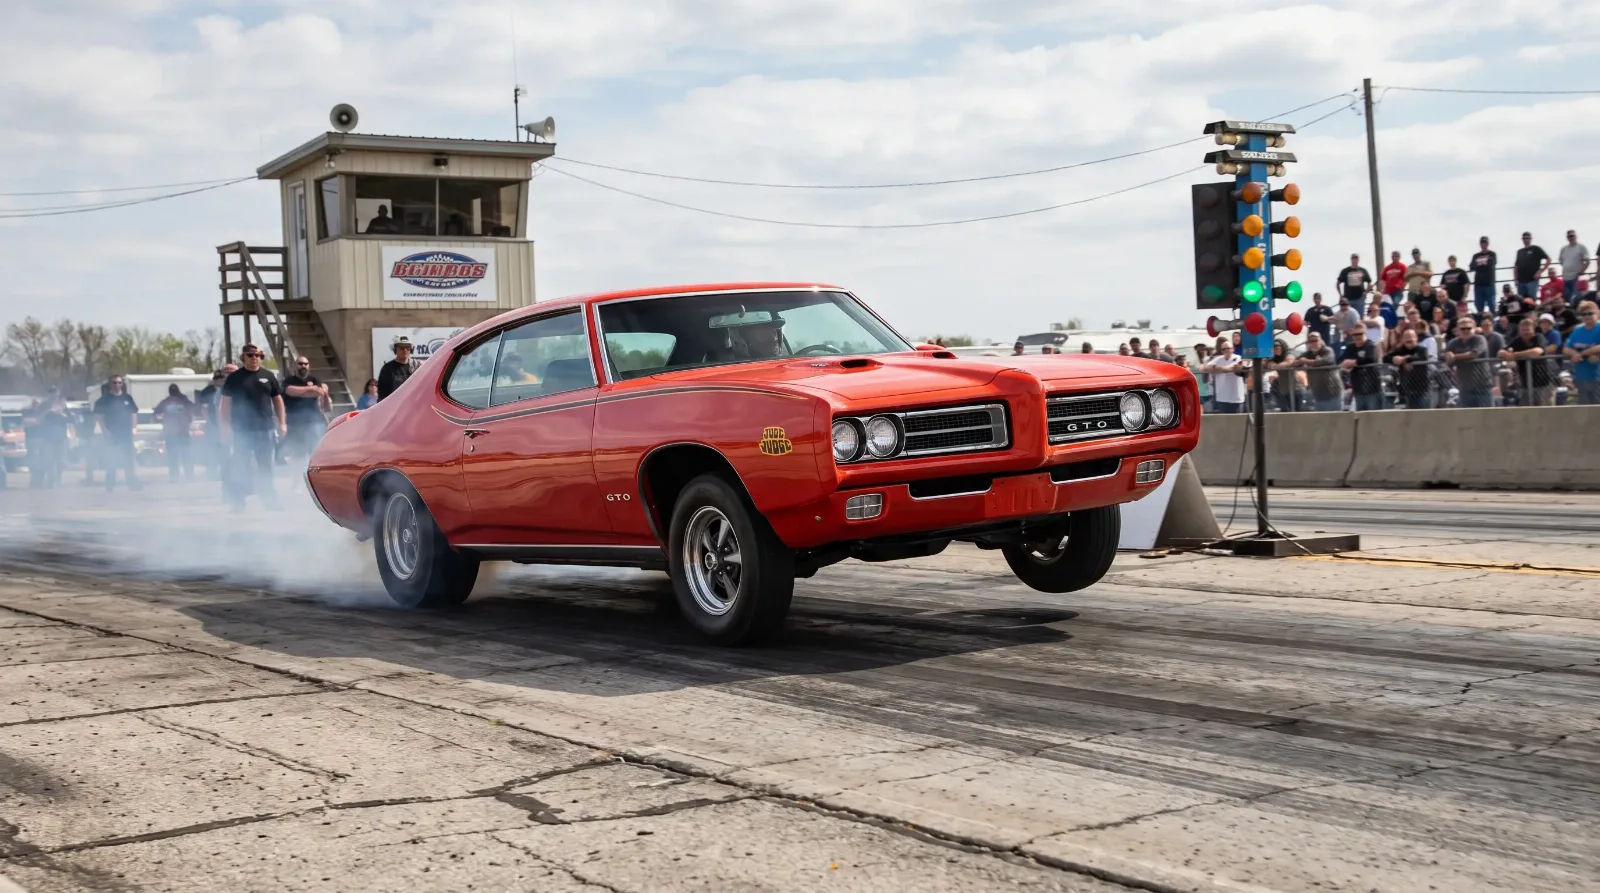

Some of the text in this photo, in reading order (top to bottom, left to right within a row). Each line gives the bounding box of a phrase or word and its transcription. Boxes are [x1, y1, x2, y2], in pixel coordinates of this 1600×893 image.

[1067, 420, 1107, 432] GTO
[760, 439, 792, 454] JUDGE
[606, 493, 631, 502] GTO
